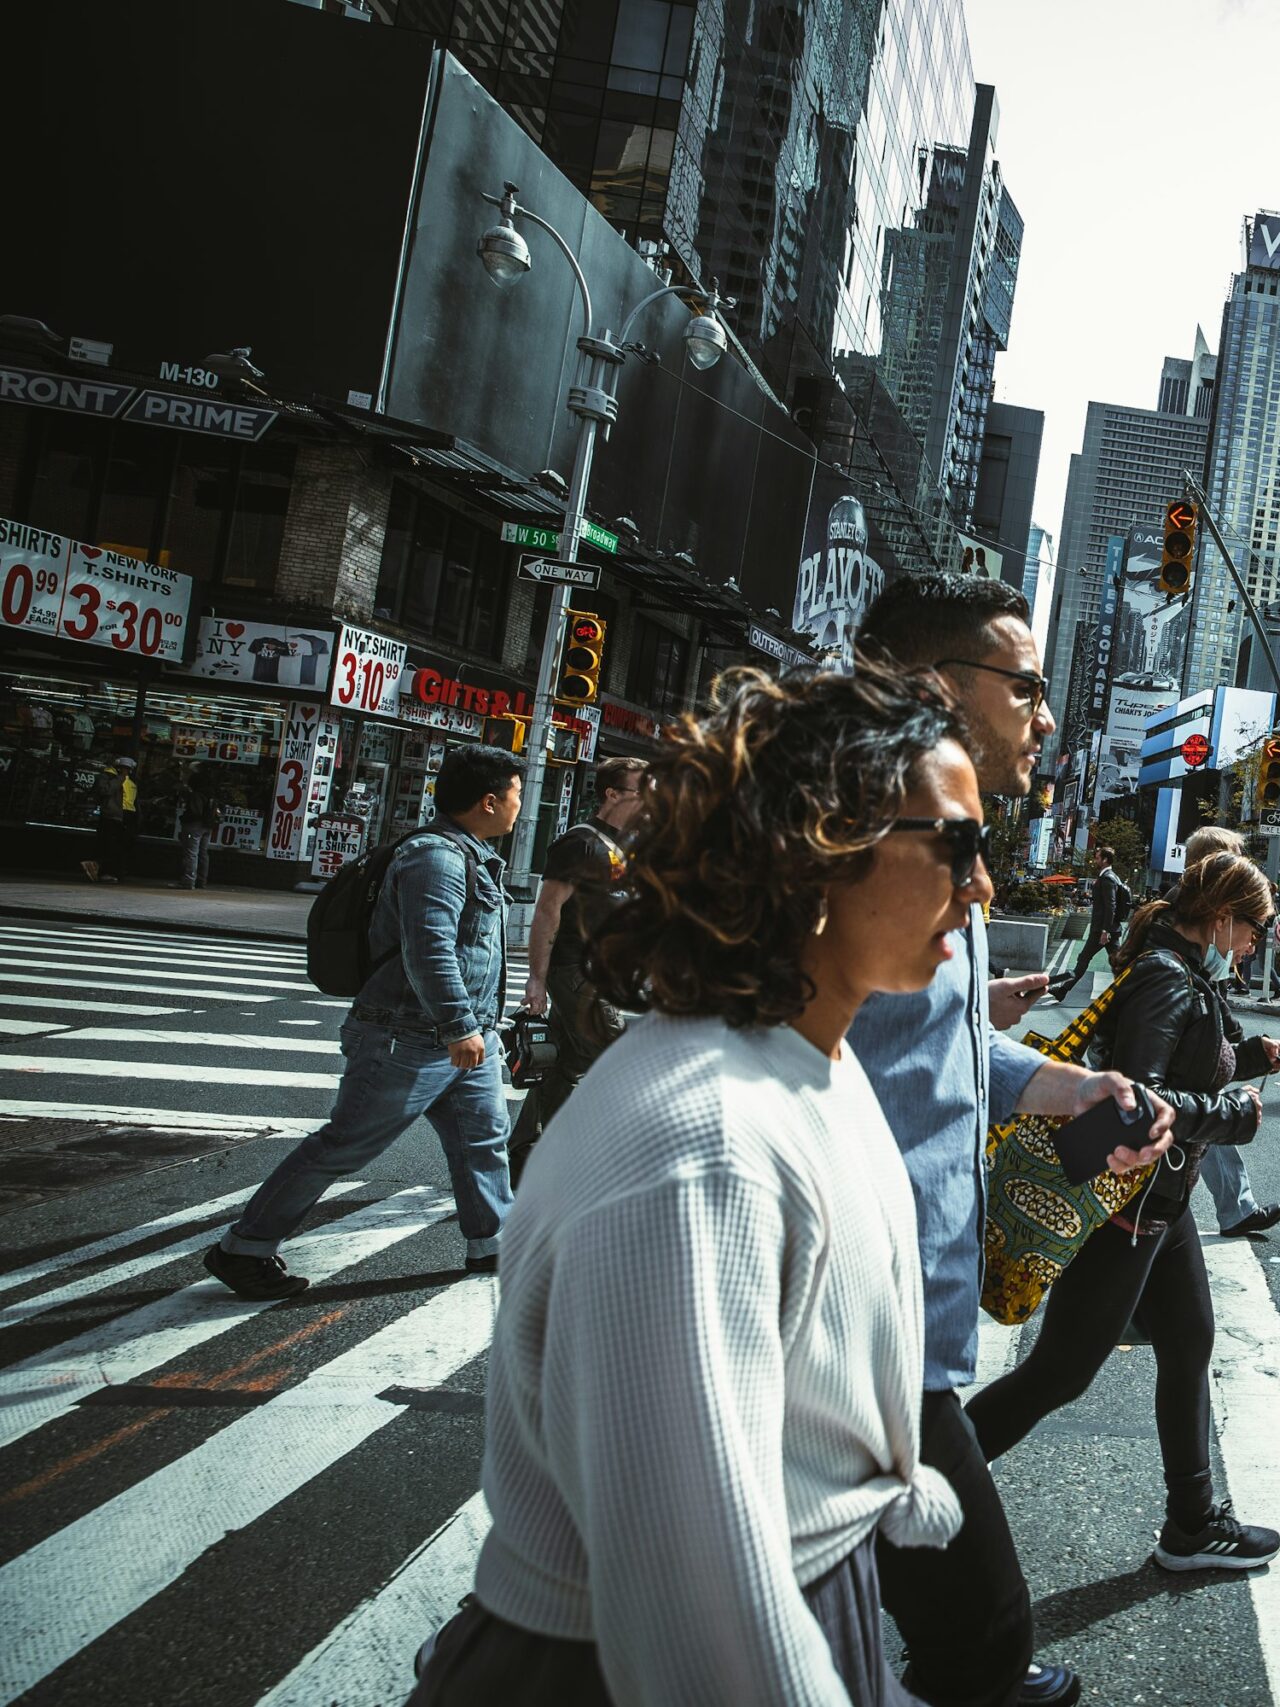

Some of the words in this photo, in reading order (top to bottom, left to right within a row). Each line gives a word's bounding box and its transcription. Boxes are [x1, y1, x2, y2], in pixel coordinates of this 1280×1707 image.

[159, 362, 219, 389] M-130
[0, 370, 118, 411] RONT
[145, 396, 258, 435] PRIME
[0, 519, 61, 558] SHIRTS
[518, 528, 529, 542] W
[533, 532, 547, 546] 50
[587, 523, 617, 552] Broadway
[830, 522, 856, 540] STANLEY
[107, 552, 138, 570] NEW
[143, 562, 178, 582] YORK
[535, 565, 559, 576] ONE
[565, 569, 588, 581] WAY
[29, 614, 56, 626] EACH
[64, 583, 100, 640] 3
[206, 638, 246, 657] NY
[752, 630, 794, 661] OUTFRONT
[339, 653, 356, 704] 3
[1093, 625, 1111, 708] SQUARE
[414, 667, 489, 715] GIFTS
[490, 690, 510, 716] &
[286, 721, 316, 740] NY
[277, 760, 303, 811] 3
[320, 820, 359, 831] SALE
[326, 830, 351, 842] NY
[1261, 825, 1274, 834] BIKE
[319, 852, 343, 865] 3
